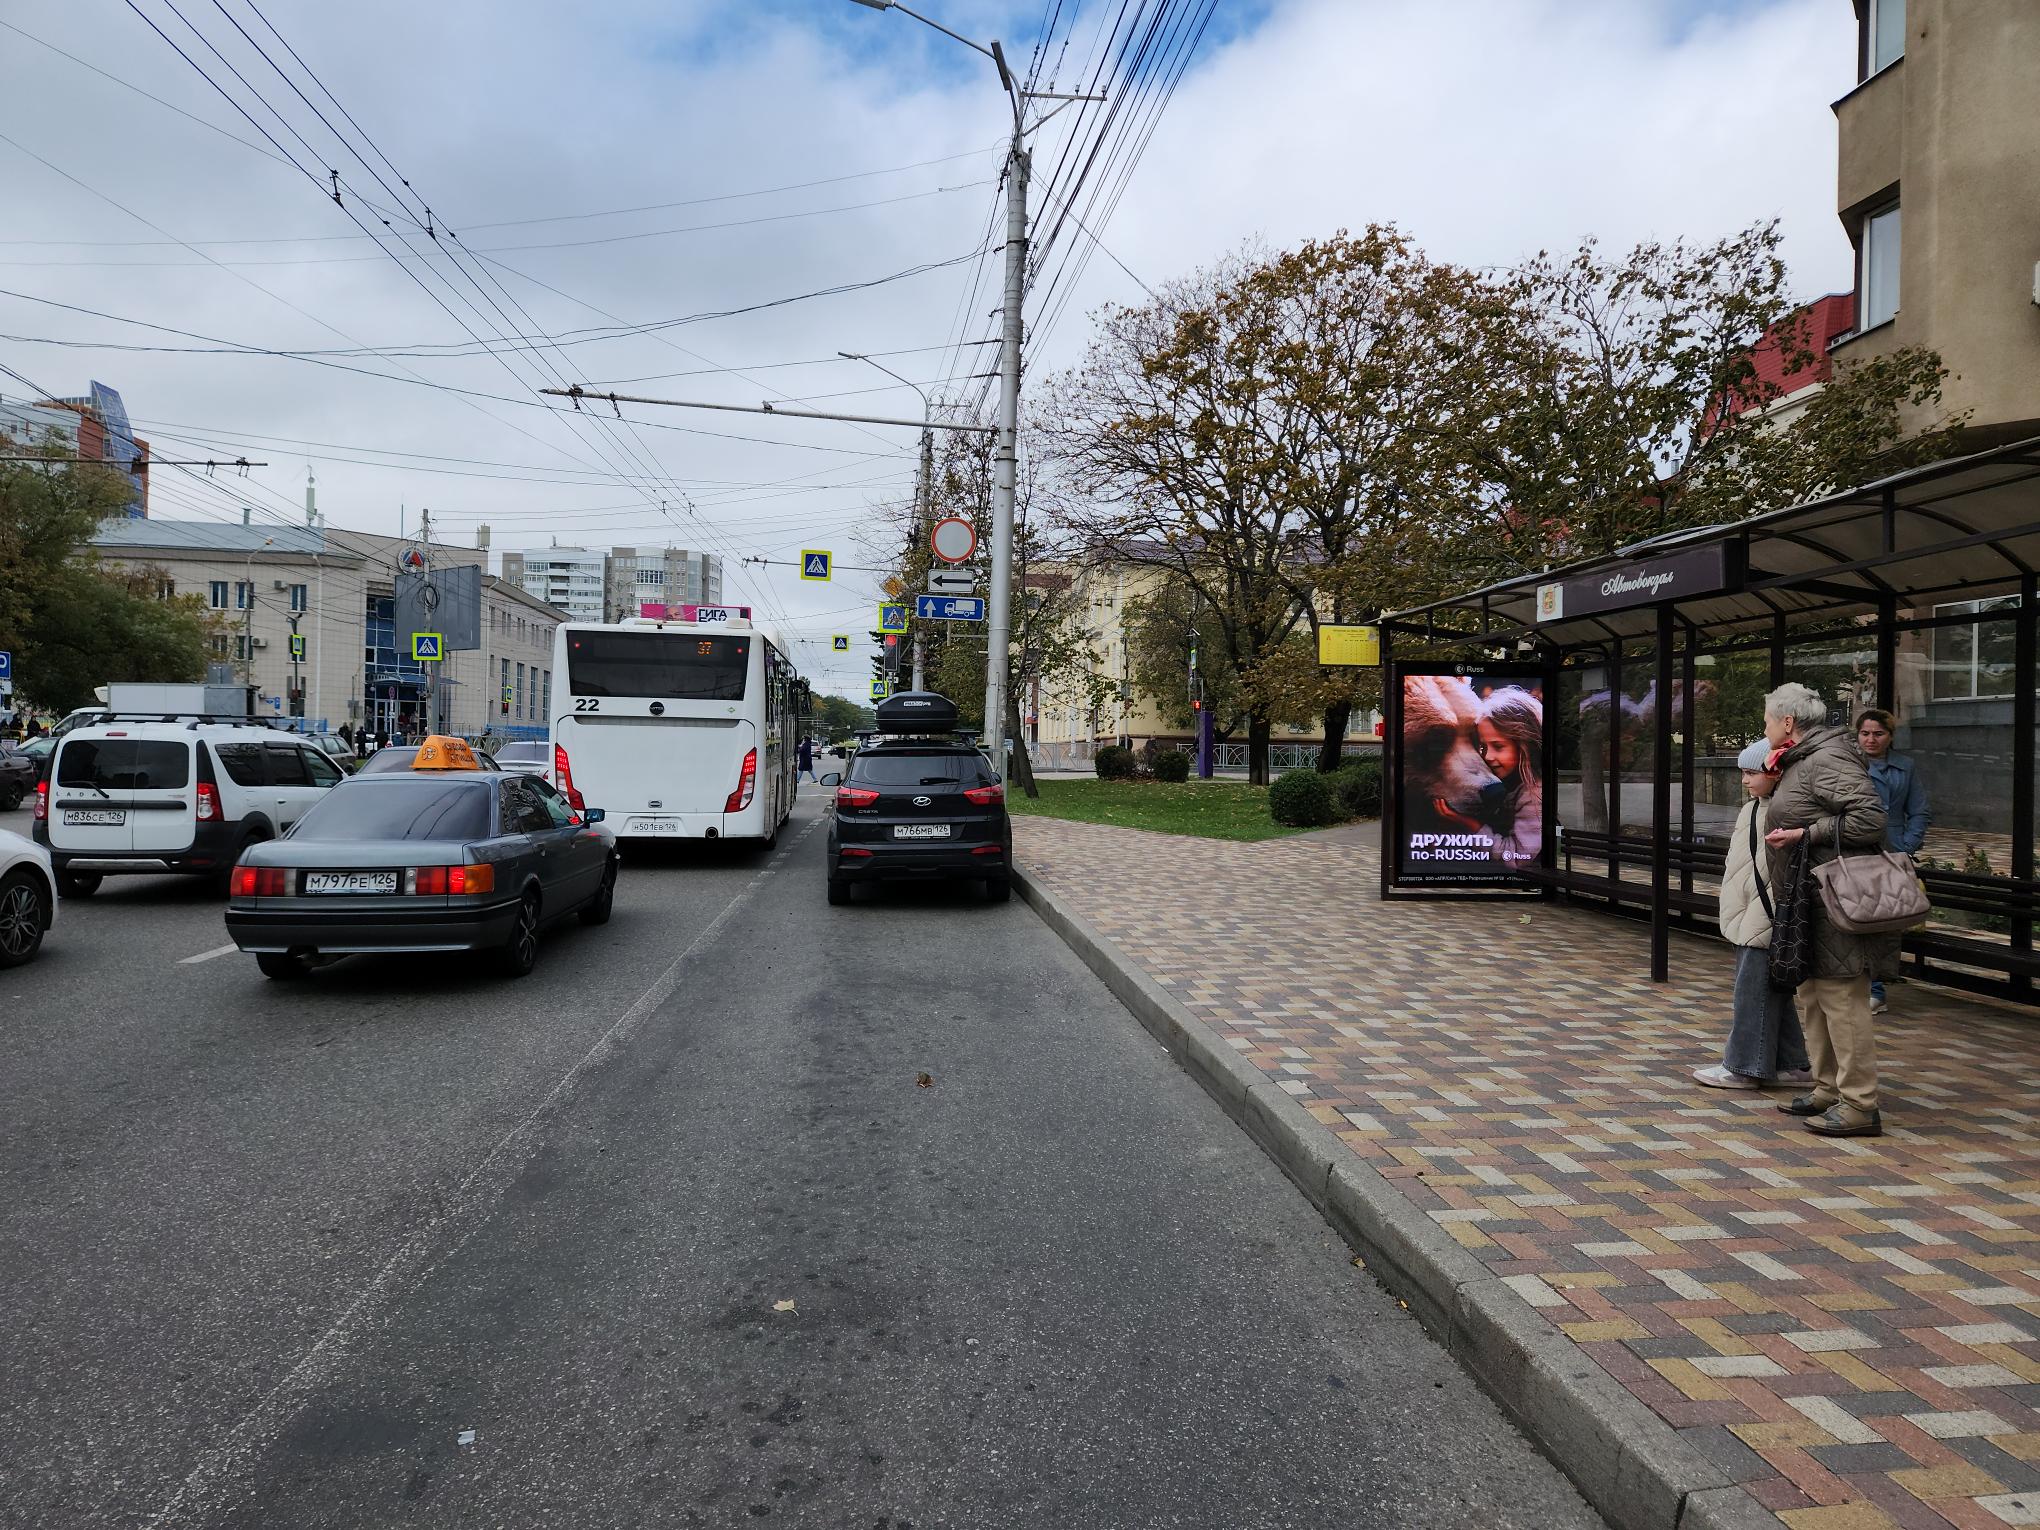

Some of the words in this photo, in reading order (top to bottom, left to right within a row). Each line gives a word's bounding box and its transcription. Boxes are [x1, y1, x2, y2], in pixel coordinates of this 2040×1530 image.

[1601, 569, 1674, 596] Автовокзал
[698, 608, 727, 618] ГИГА
[1466, 665, 1485, 673] Russ
[575, 699, 600, 712] 22
[56, 790, 98, 798] LADA
[106, 811, 122, 820] 126
[934, 824, 949, 833] 126
[1410, 833, 1494, 849] ДРУЖИТЬ
[1411, 849, 1491, 861] по-RUSSки
[1512, 852, 1532, 860] Russ
[370, 873, 392, 885] 126
